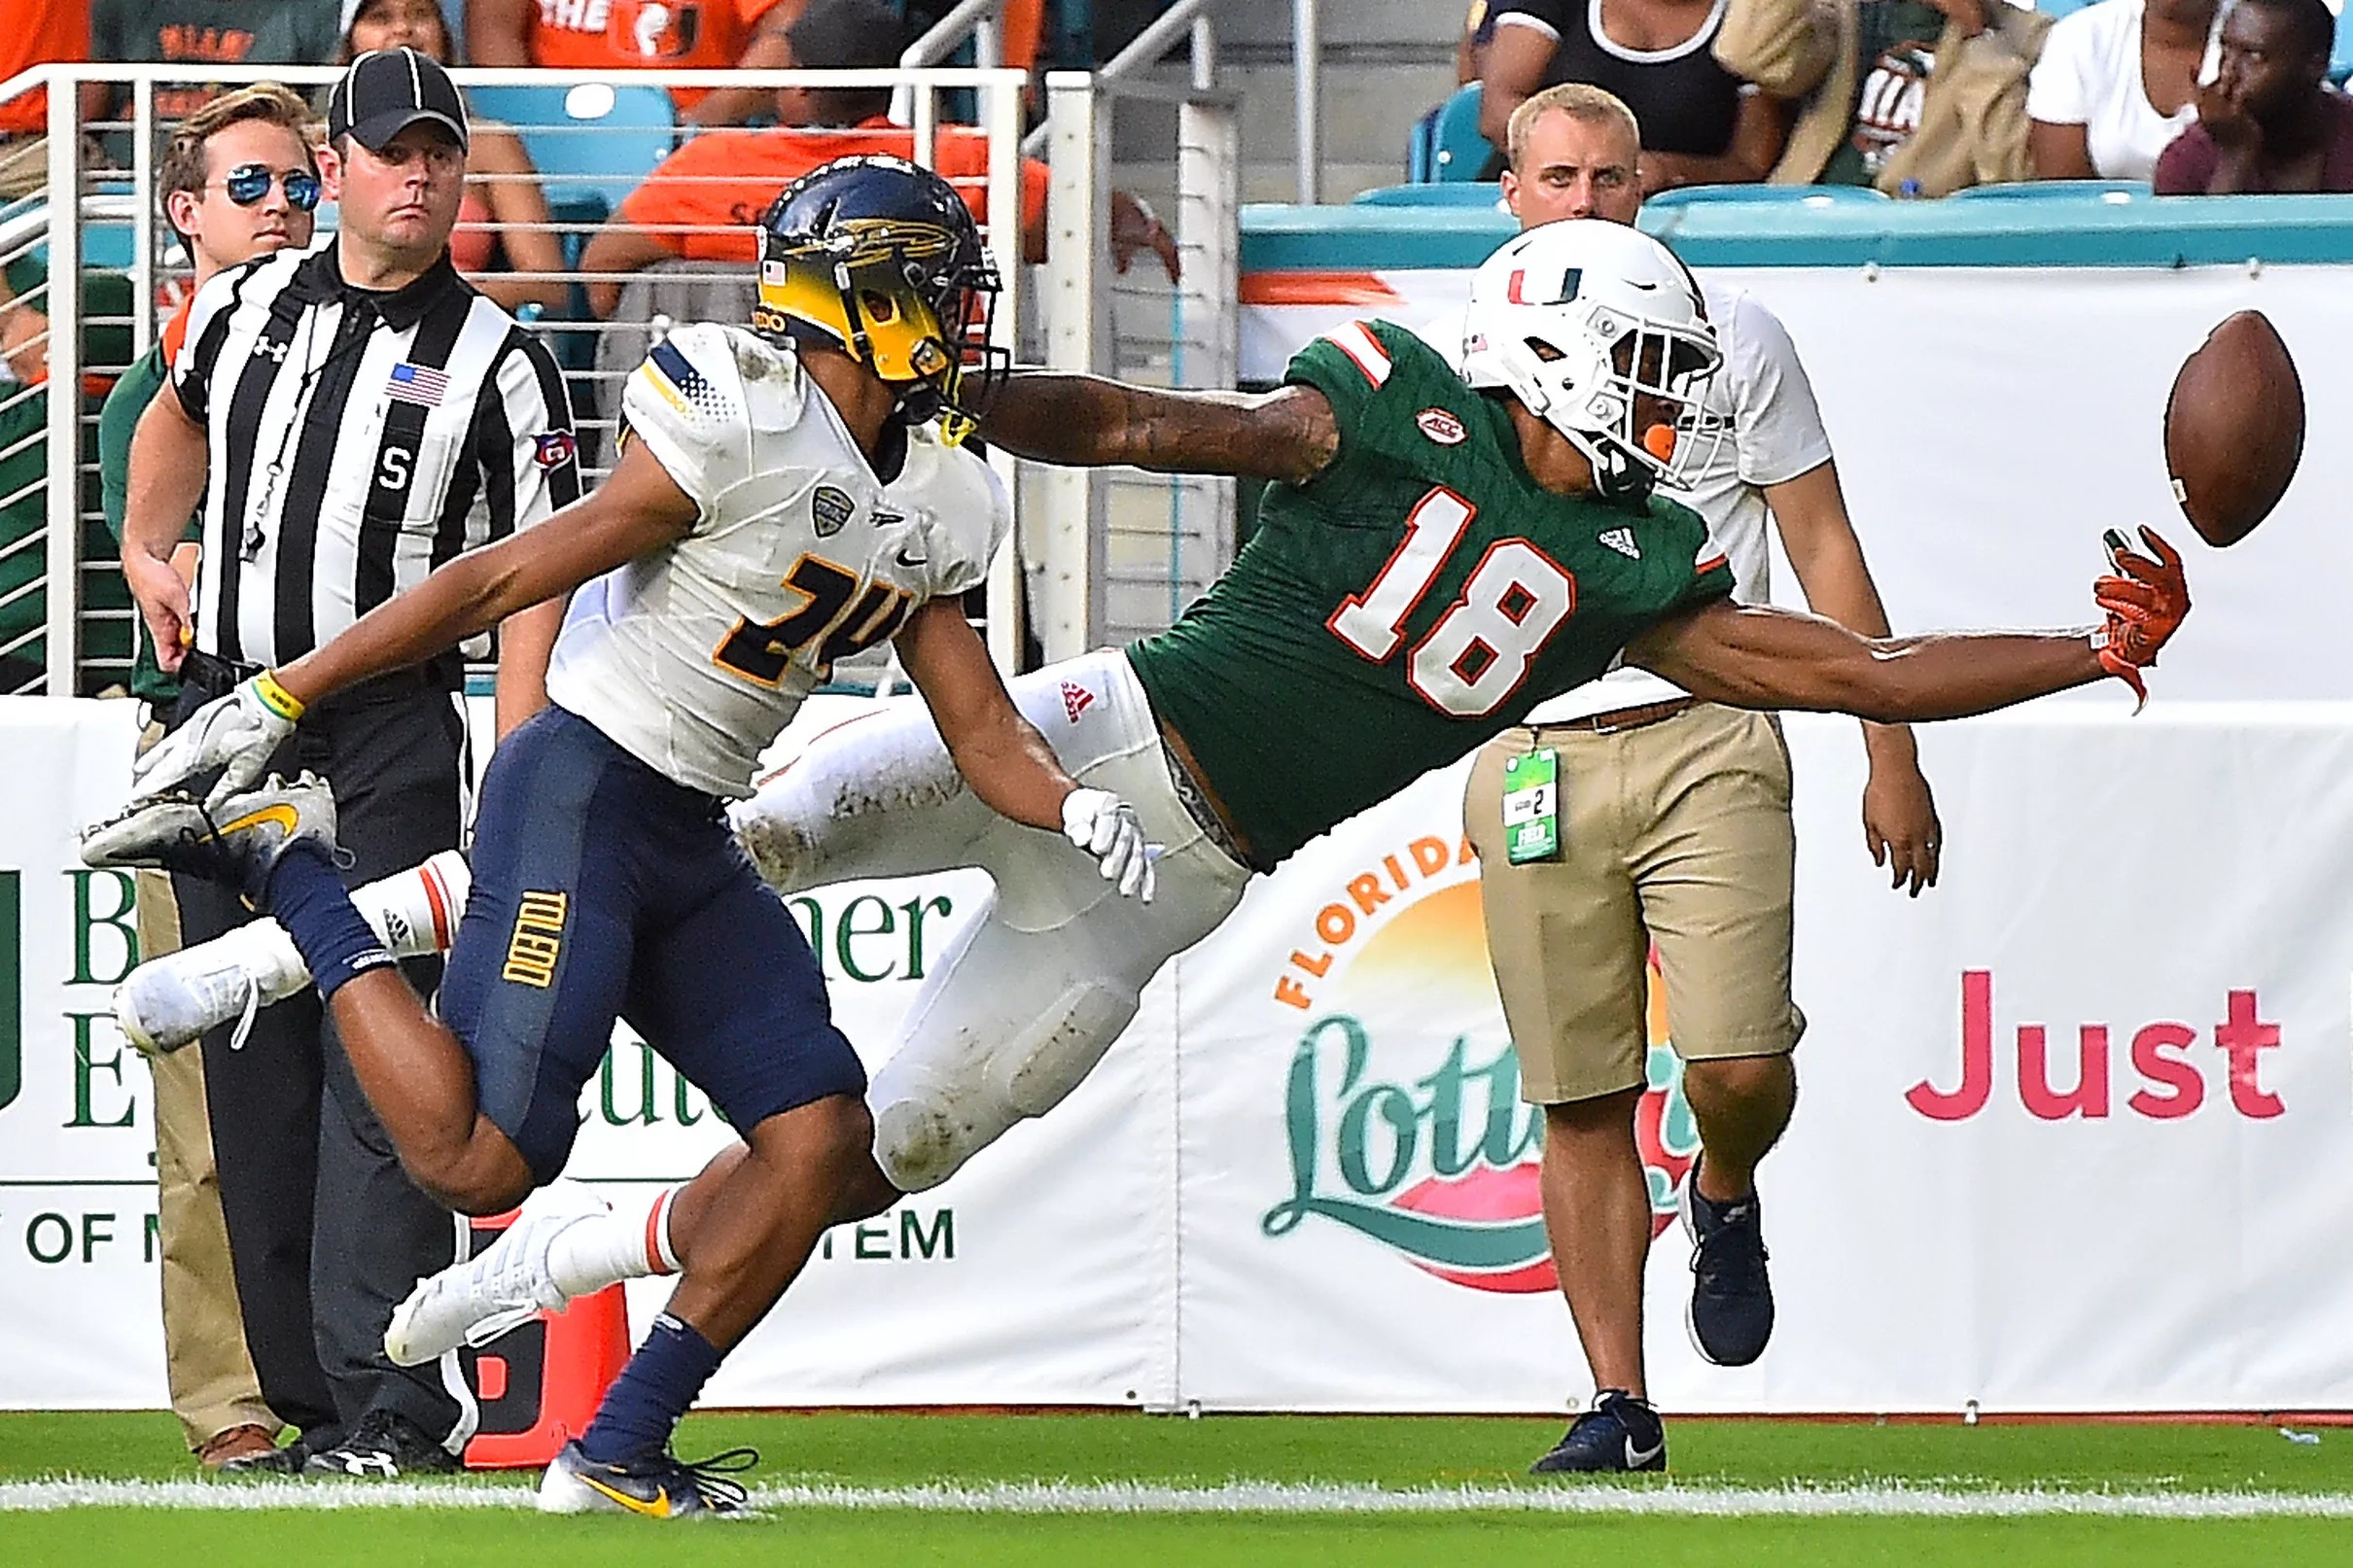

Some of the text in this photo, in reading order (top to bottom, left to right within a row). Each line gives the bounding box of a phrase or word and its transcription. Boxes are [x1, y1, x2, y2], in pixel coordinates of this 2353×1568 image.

[378, 446, 411, 490] S
[1326, 486, 1577, 718] 18
[503, 891, 567, 988] TOLEDO
[1904, 969, 2286, 1121] Just
[26, 1212, 116, 1264] OF
